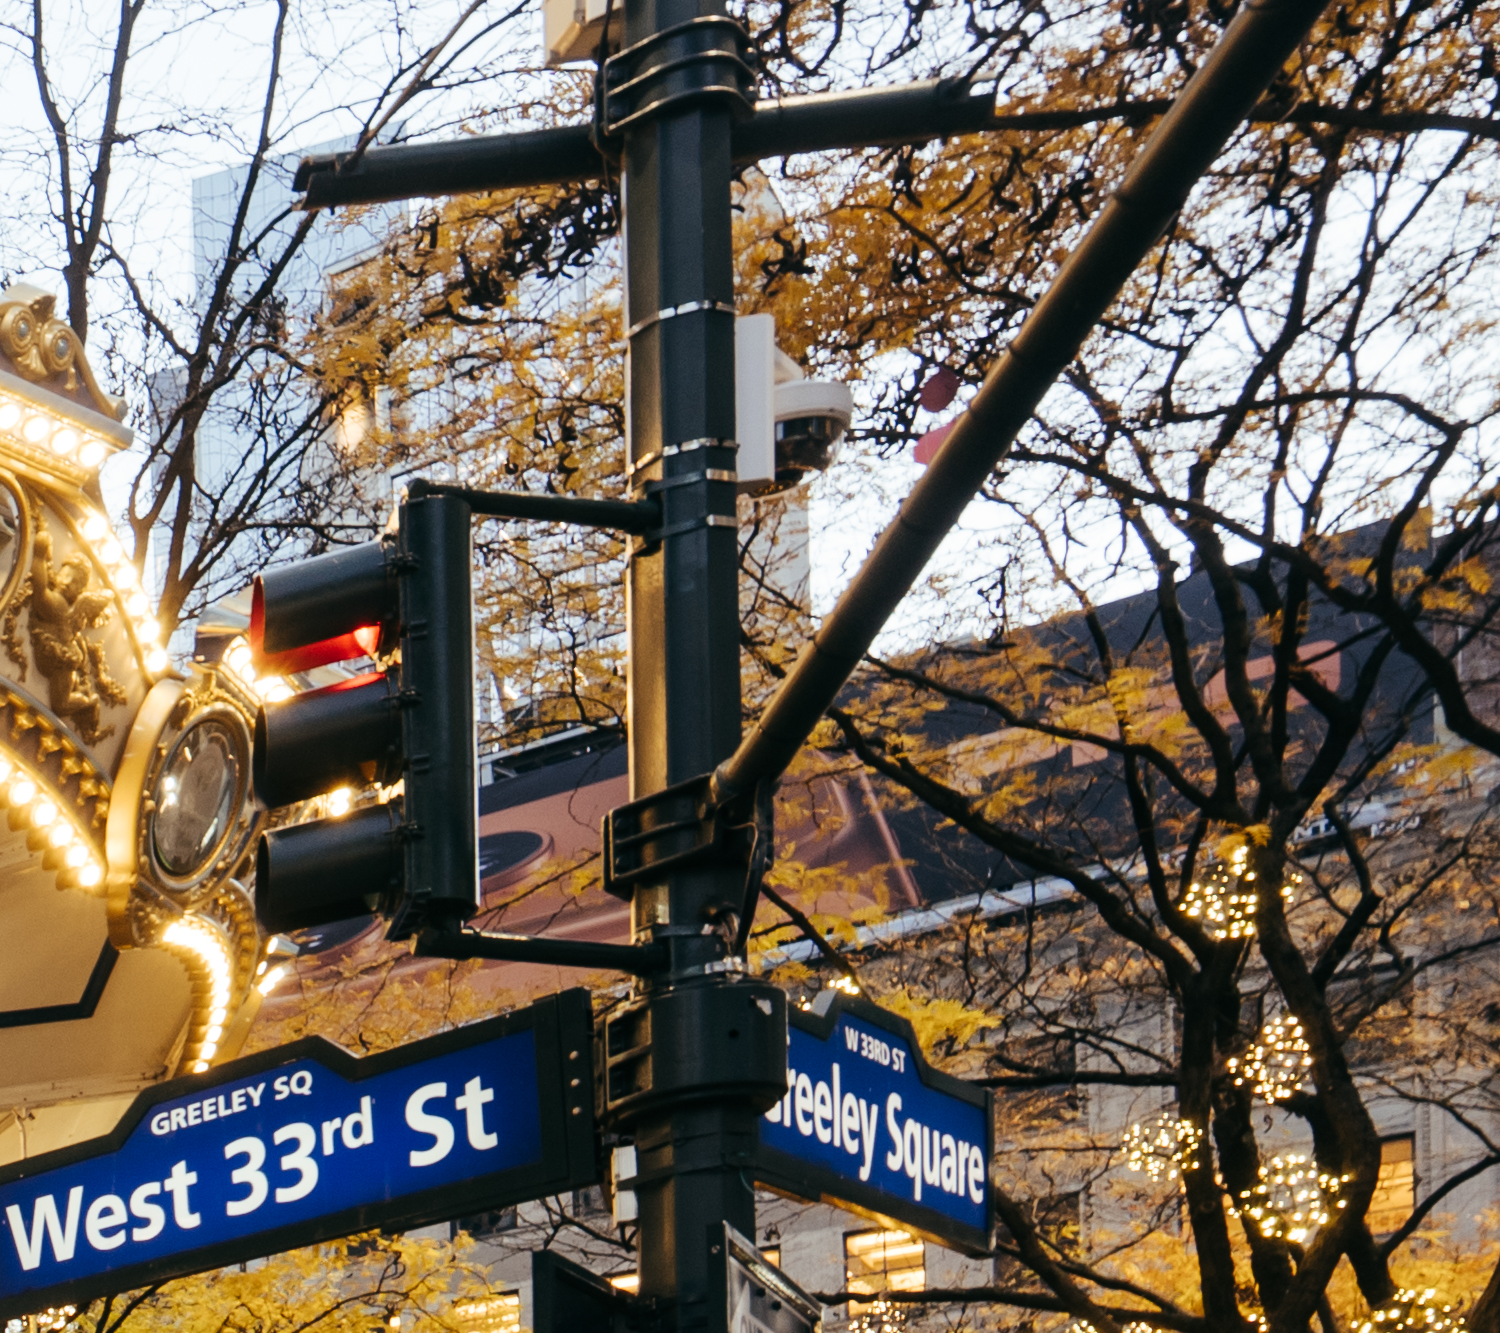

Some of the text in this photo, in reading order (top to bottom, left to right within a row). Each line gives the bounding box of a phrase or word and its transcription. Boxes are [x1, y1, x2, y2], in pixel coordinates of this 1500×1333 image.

[844, 1025, 906, 1073] W 33RD ST
[149, 1069, 314, 1137] GREELEY SQ
[764, 1062, 984, 1204] reeley Square
[4, 1074, 500, 1272] West 33rd St
